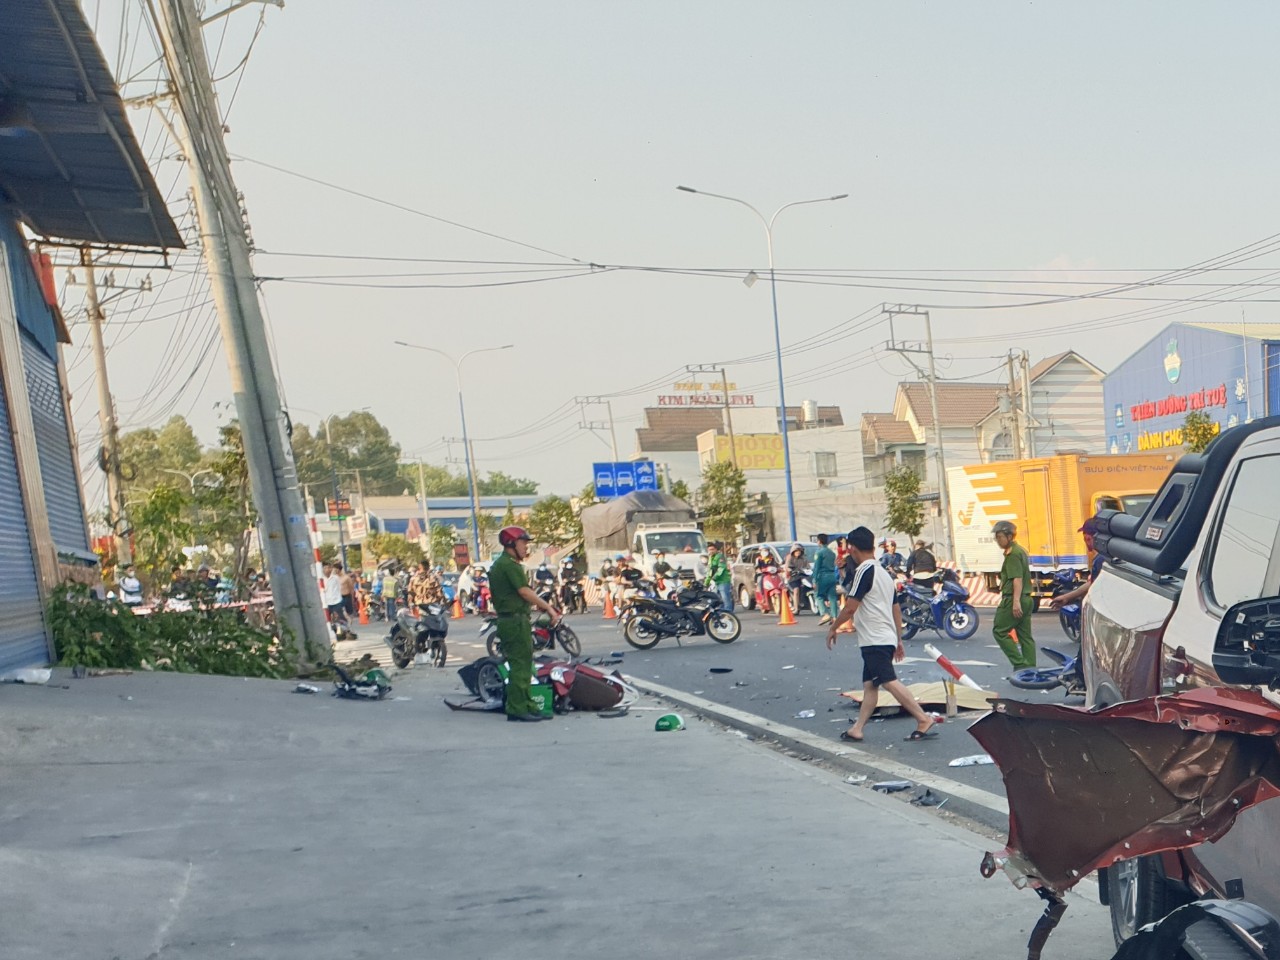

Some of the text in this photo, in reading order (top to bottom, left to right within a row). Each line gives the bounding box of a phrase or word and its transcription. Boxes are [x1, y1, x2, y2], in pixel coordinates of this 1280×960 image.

[658, 395, 684, 406] KIM
[1188, 388, 1206, 410] TRÍ
[1206, 384, 1227, 409] TUỆ
[717, 438, 783, 451] PHOTO
[1137, 431, 1163, 450] DÀNH
[1163, 428, 1184, 447] CHO
